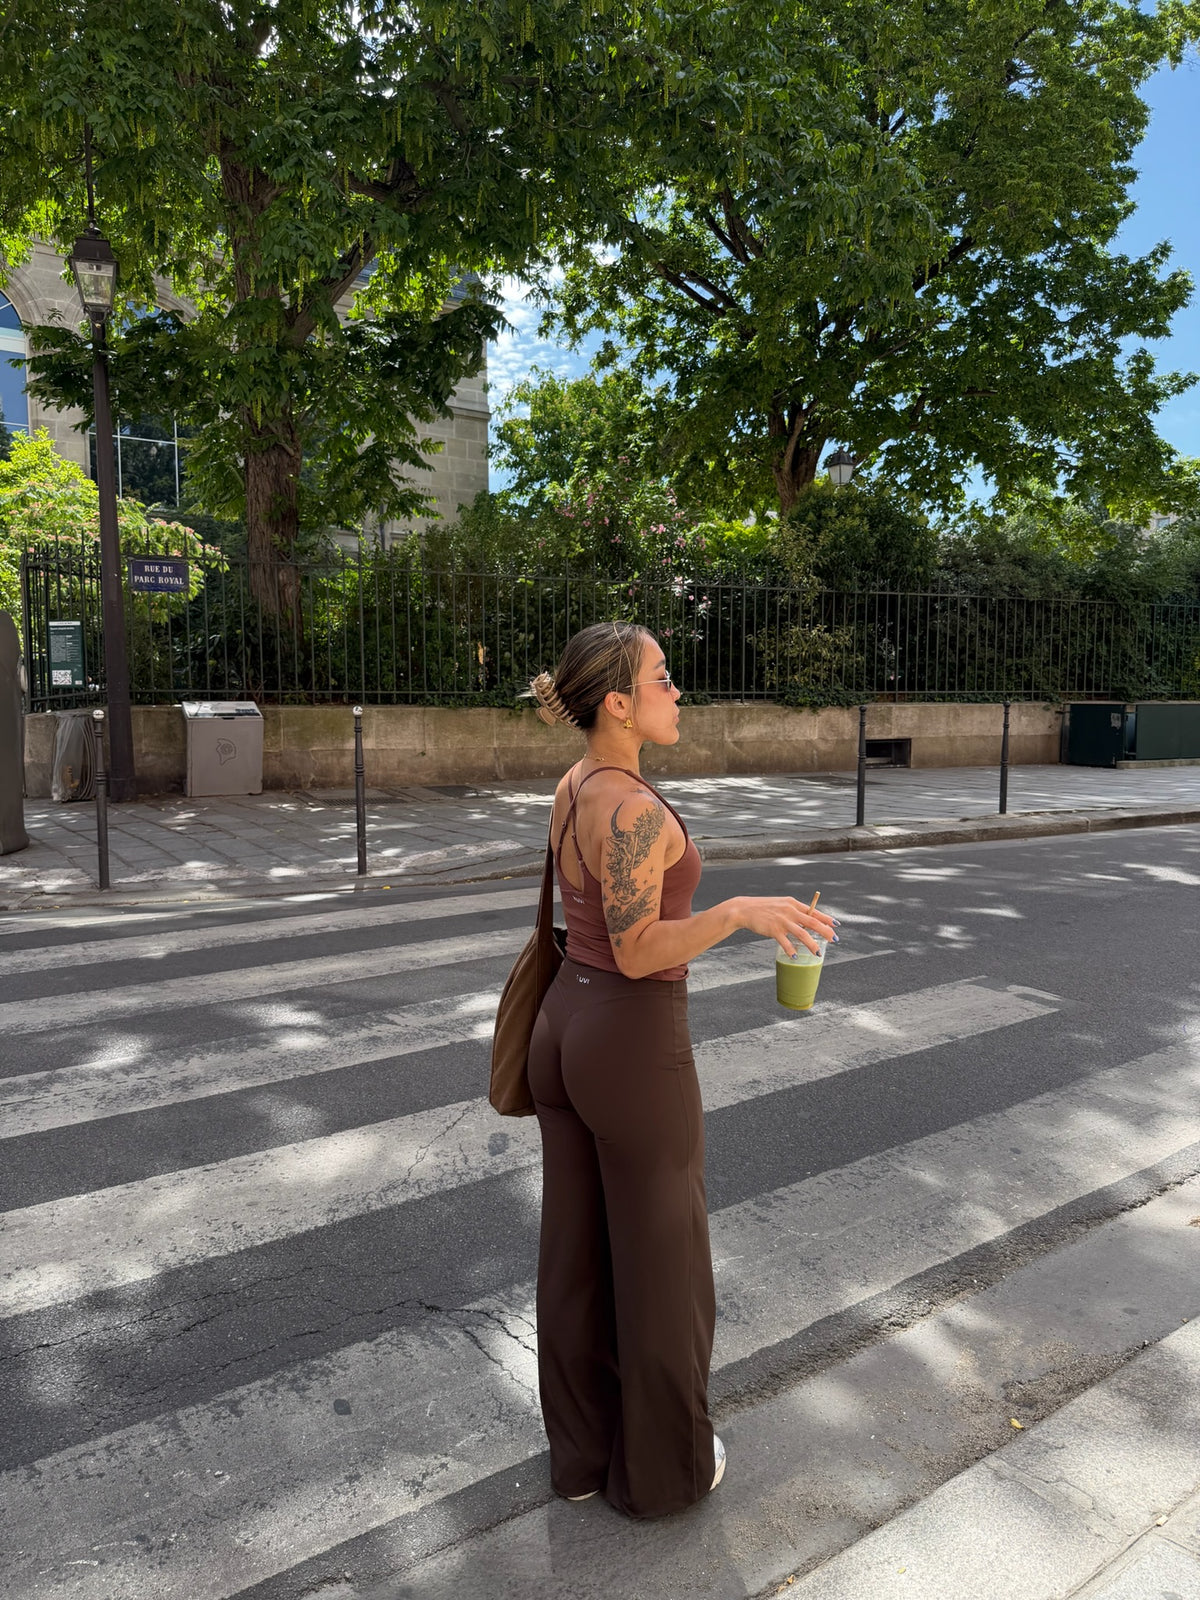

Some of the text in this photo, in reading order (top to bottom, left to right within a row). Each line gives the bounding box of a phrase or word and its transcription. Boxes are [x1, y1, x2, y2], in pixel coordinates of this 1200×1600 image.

[144, 565, 160, 573] RUE
[134, 575, 185, 585] PARC ROYAL
